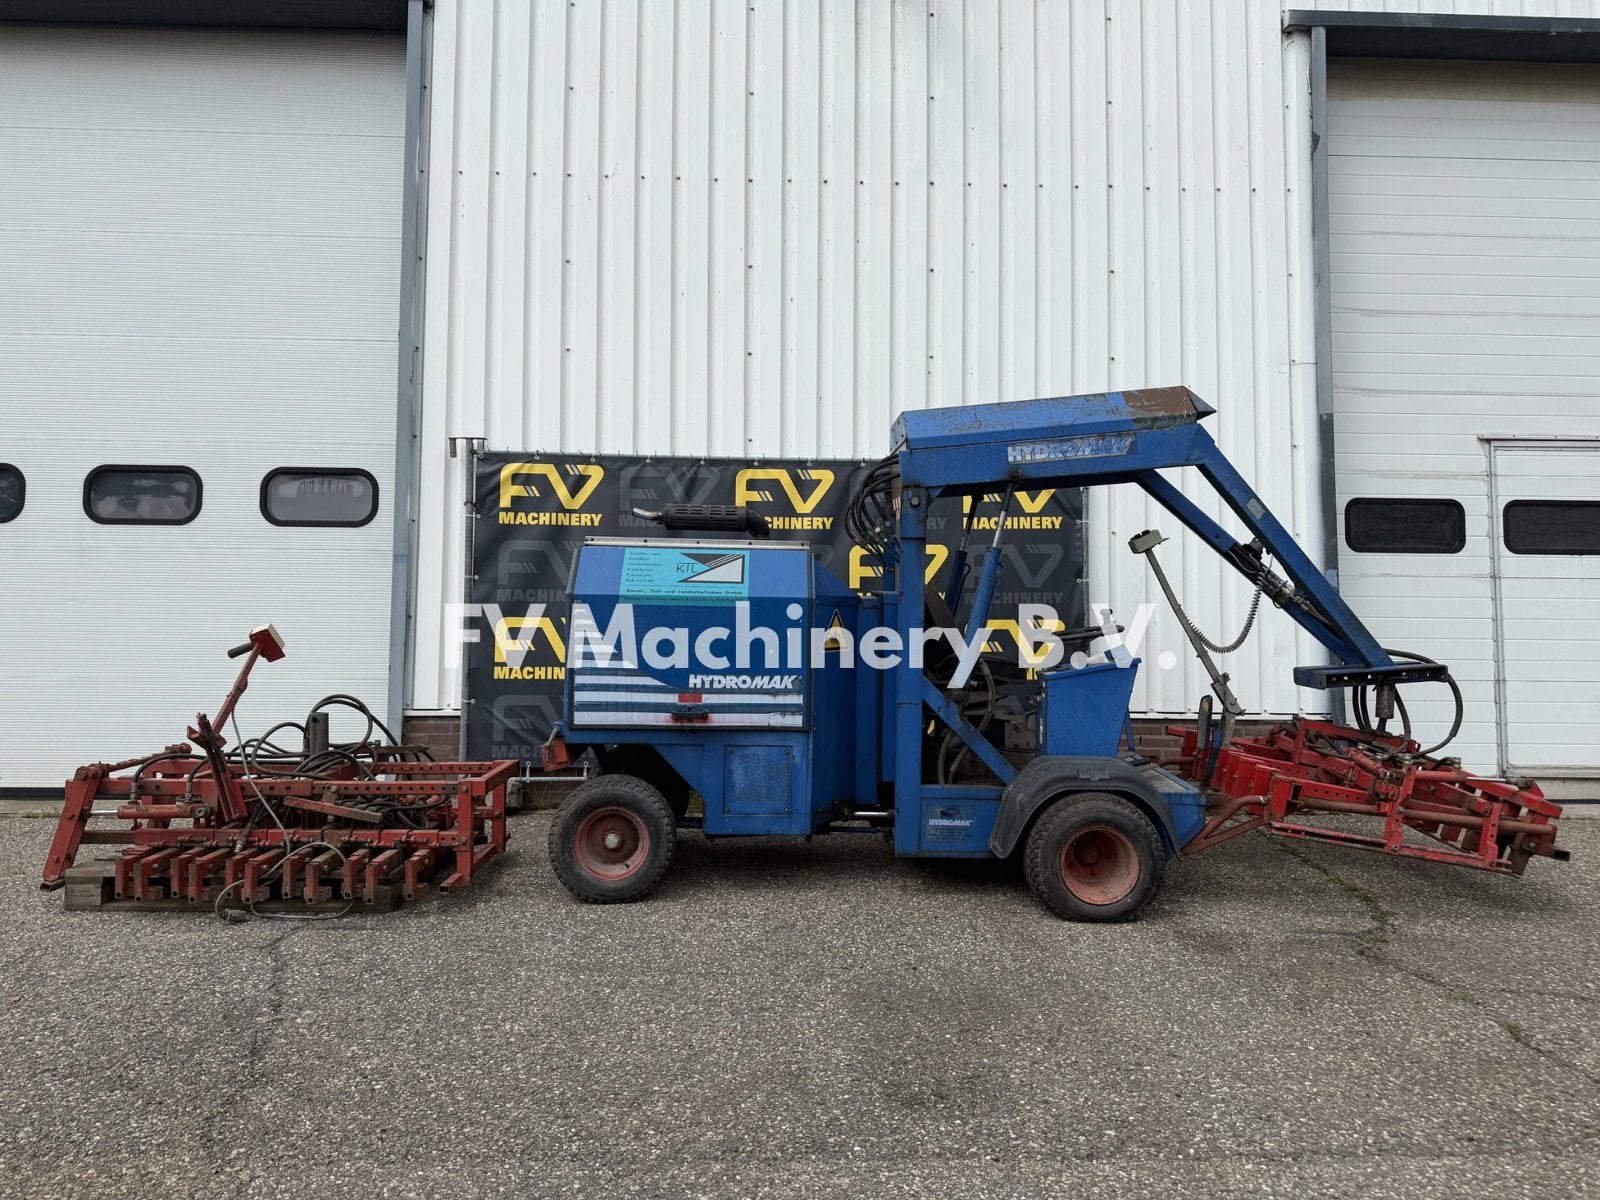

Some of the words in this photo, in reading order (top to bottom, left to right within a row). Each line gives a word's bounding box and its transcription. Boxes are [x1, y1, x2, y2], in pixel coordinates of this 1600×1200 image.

[1007, 436, 1136, 462] HYDROMAK
[499, 463, 604, 510] FV
[498, 511, 603, 527] MACHINERY
[764, 516, 834, 530] HINERY
[676, 563, 699, 574] KTL
[496, 588, 569, 602] MACHIN
[964, 592, 1064, 605] MCHINERY
[494, 666, 566, 680] MACHIN
[688, 674, 798, 689] HYDROMAK
